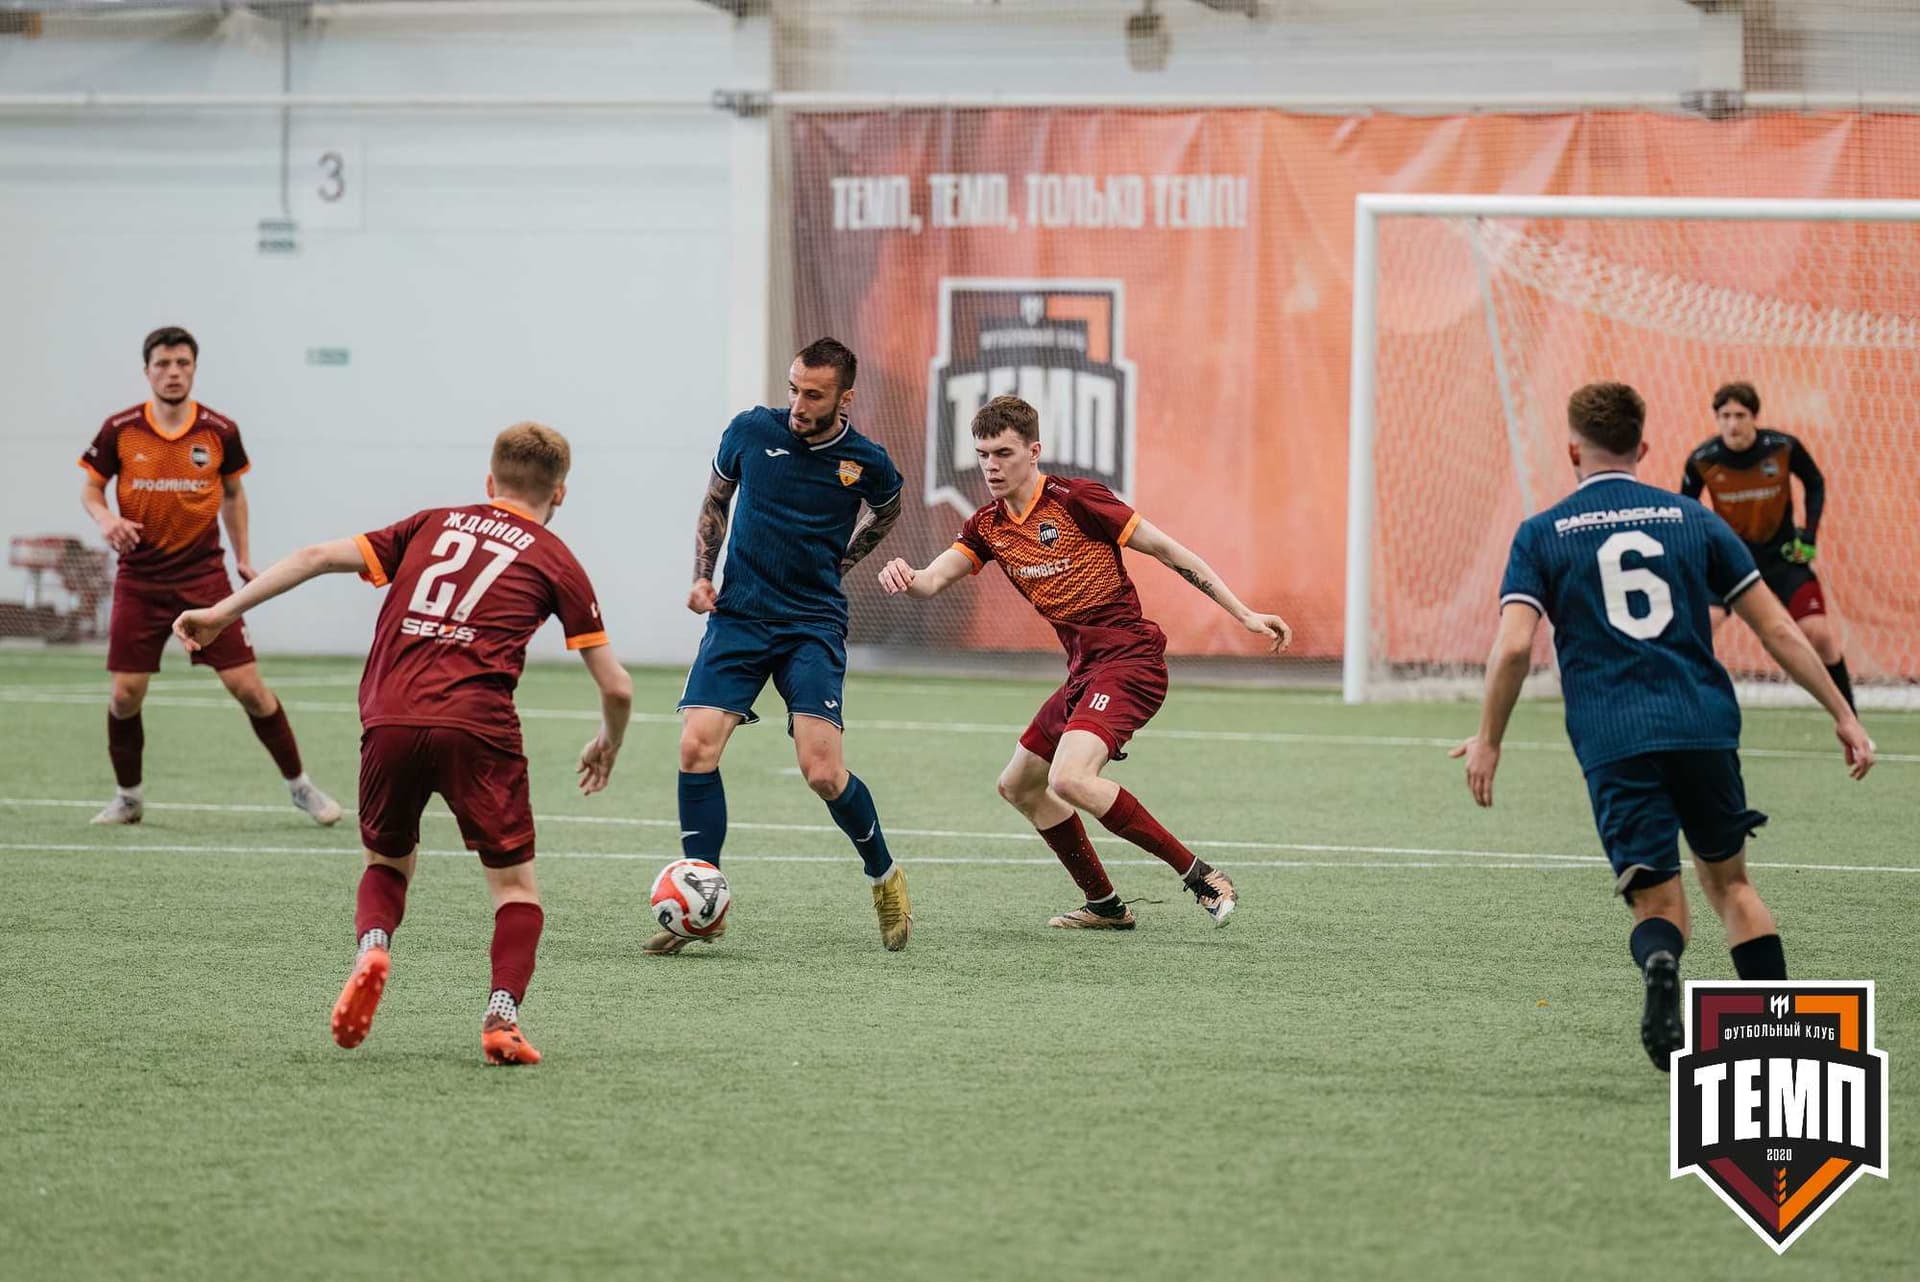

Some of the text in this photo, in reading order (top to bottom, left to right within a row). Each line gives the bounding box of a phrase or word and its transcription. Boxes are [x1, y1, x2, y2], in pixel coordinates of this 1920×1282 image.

[318, 151, 346, 203] 3
[831, 172, 1248, 234] ТЕМП, ТЕМП, ТОЛЬКО ТЕМП!
[443, 511, 536, 551] ЖДАНОВ
[408, 529, 519, 623] 27
[1596, 530, 1674, 641] 6
[1088, 692, 1111, 712] 18
